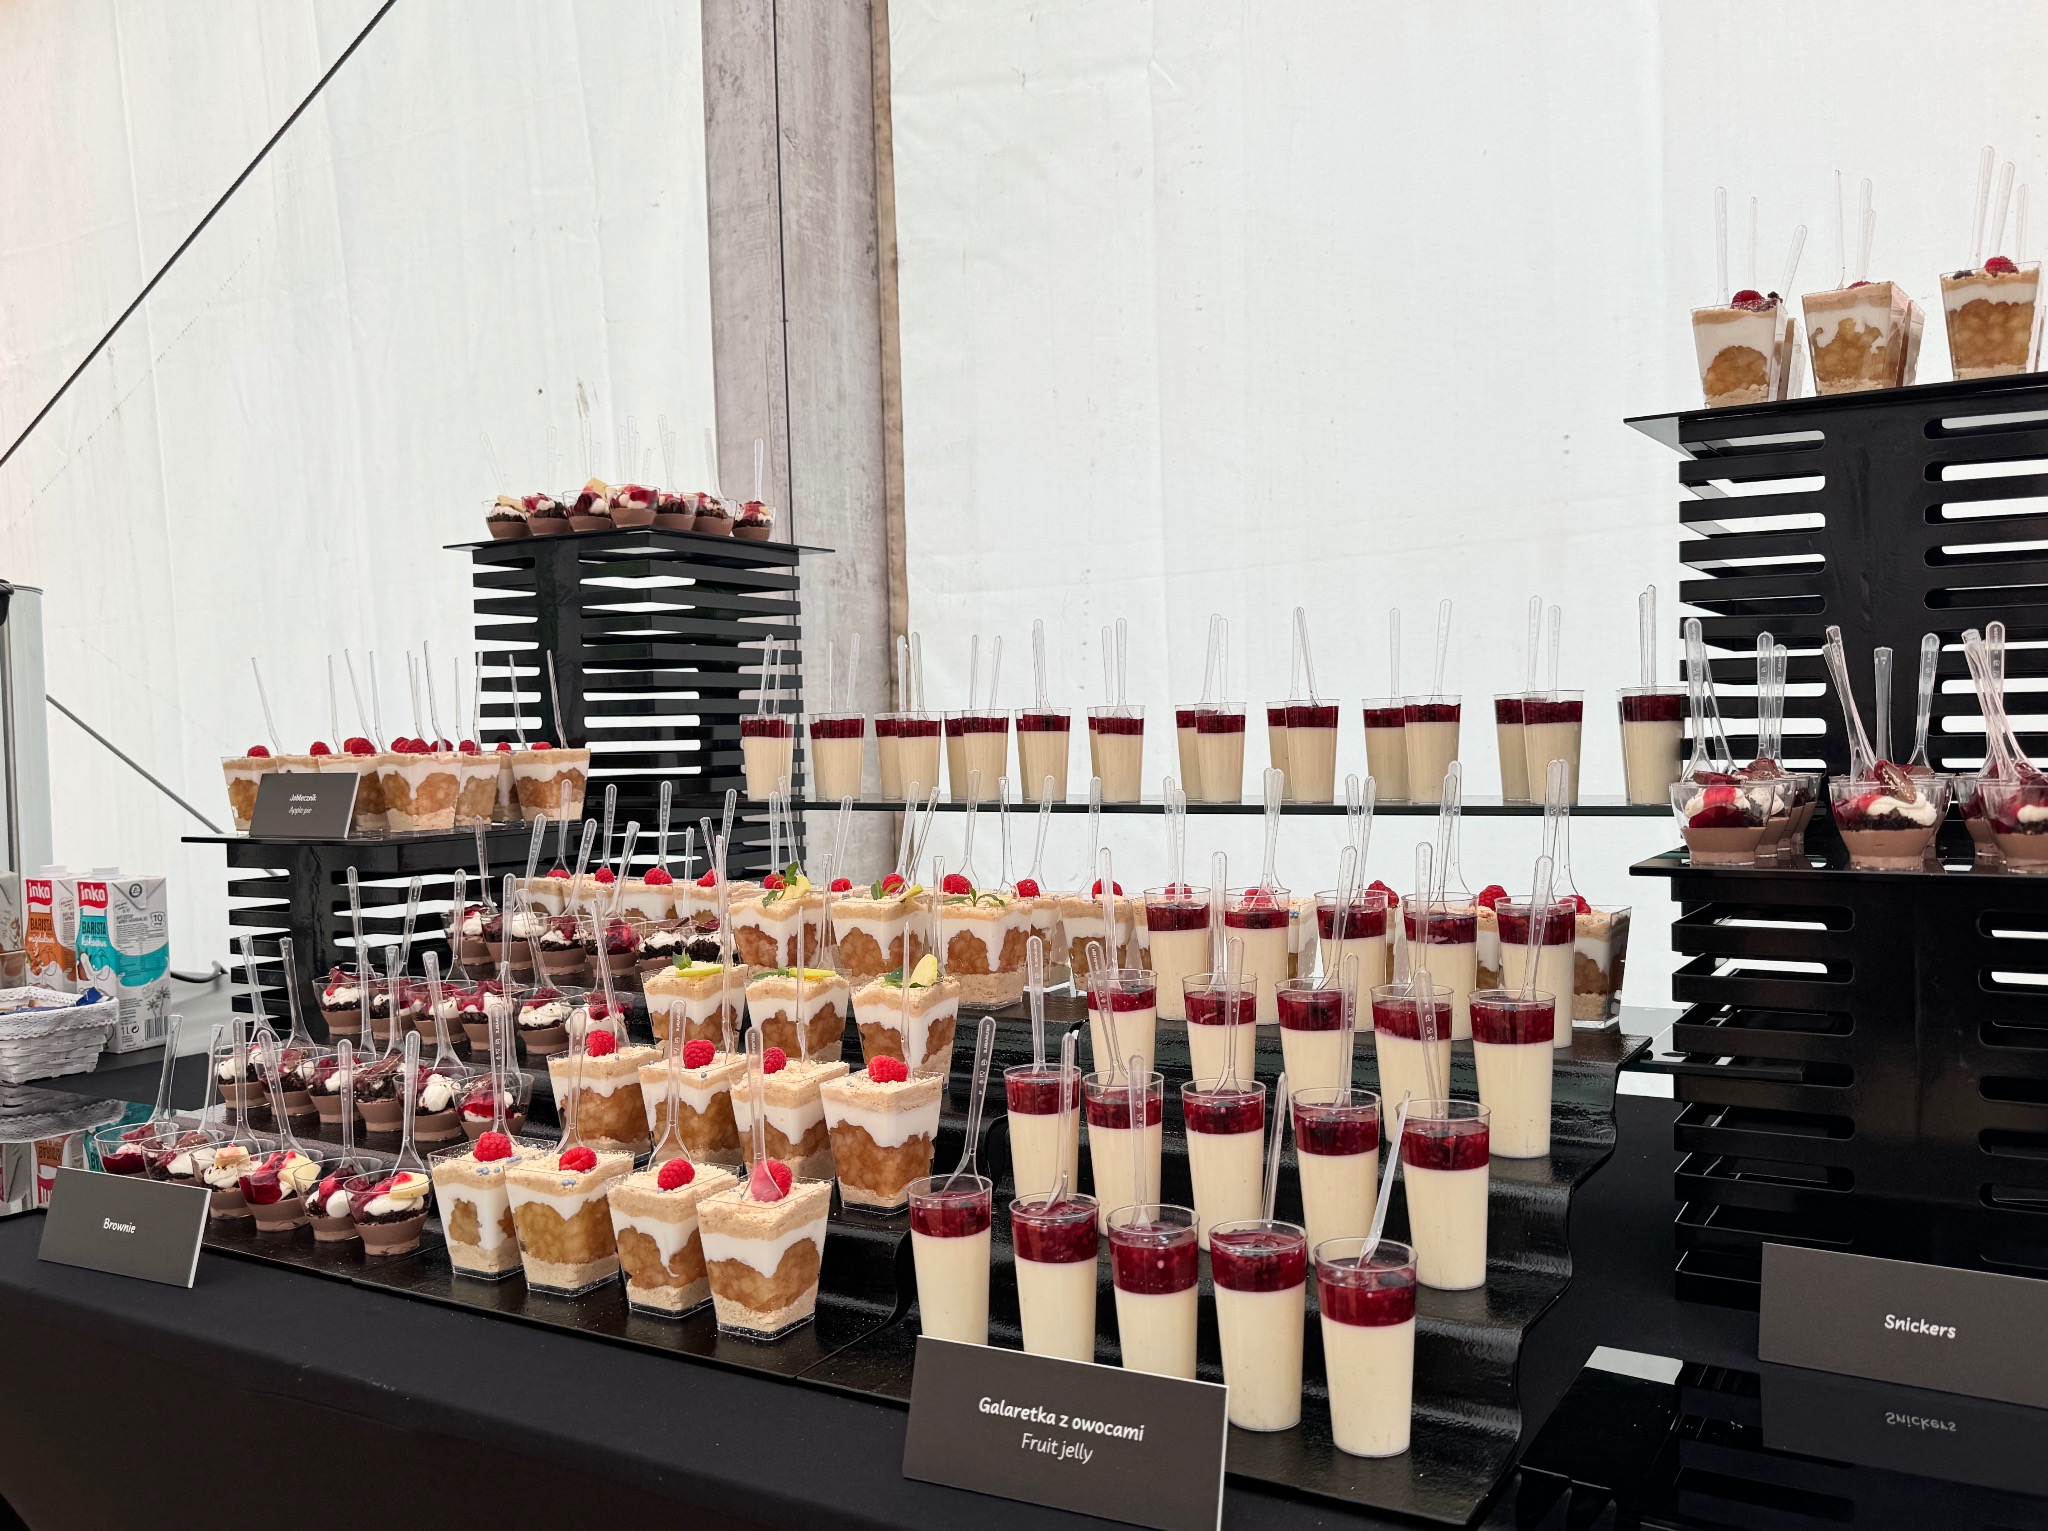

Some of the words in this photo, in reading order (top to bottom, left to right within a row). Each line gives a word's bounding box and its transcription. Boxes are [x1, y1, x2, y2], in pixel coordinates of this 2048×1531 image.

[28, 881, 51, 899] inka
[80, 884, 106, 902] inka
[30, 918, 53, 932] BARISTA
[153, 914, 163, 922] 10
[82, 921, 107, 935] BARISTA
[103, 1217, 137, 1234] Brownie
[1884, 1314, 1957, 1339] Snickers
[978, 1396, 1056, 1426] Galaretka
[1058, 1414, 1069, 1428] z
[1071, 1416, 1145, 1442] owocami
[1021, 1432, 1058, 1455] Fruit
[1057, 1440, 1093, 1465] jelly
